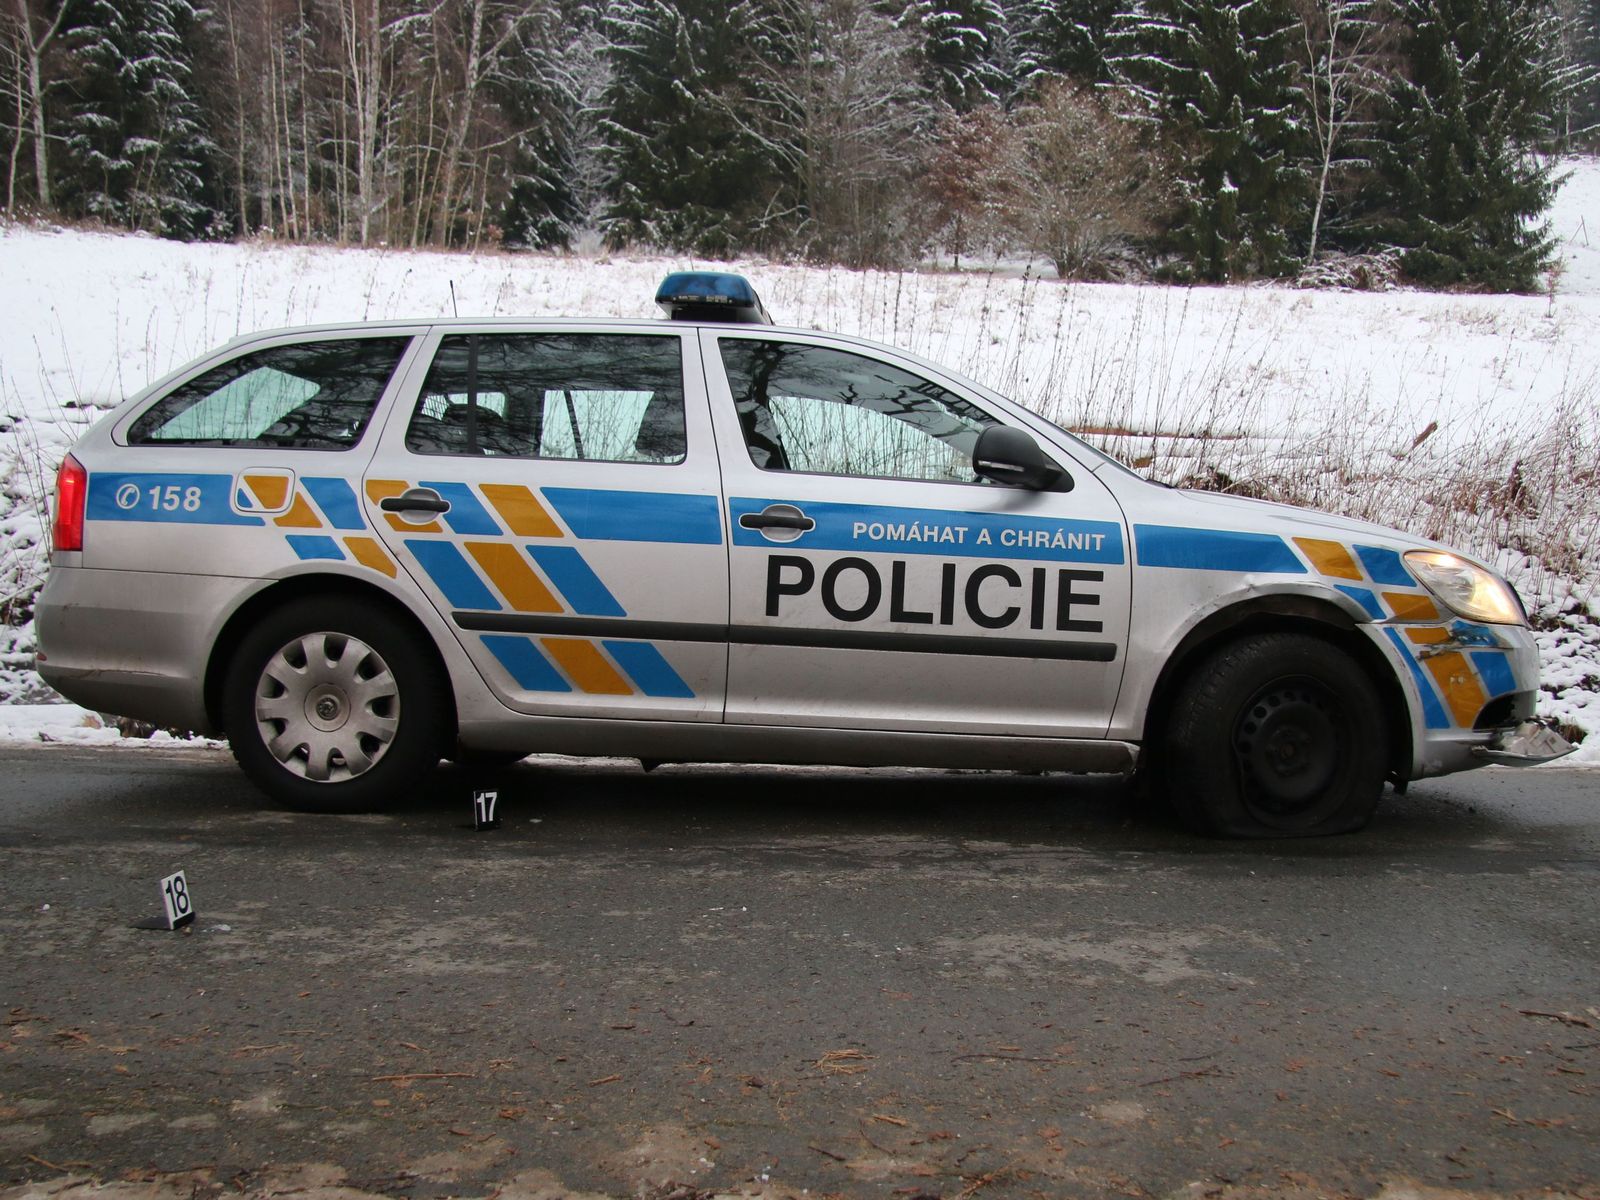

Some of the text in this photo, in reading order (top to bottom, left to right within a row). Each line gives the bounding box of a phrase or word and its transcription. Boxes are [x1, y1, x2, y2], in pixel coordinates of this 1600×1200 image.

[149, 485, 202, 512] 158
[852, 520, 1106, 551] POMÁHAT A CHRÁNIT
[765, 554, 1104, 633] POLICIE
[476, 791, 498, 823] 17
[165, 875, 190, 918] 18
